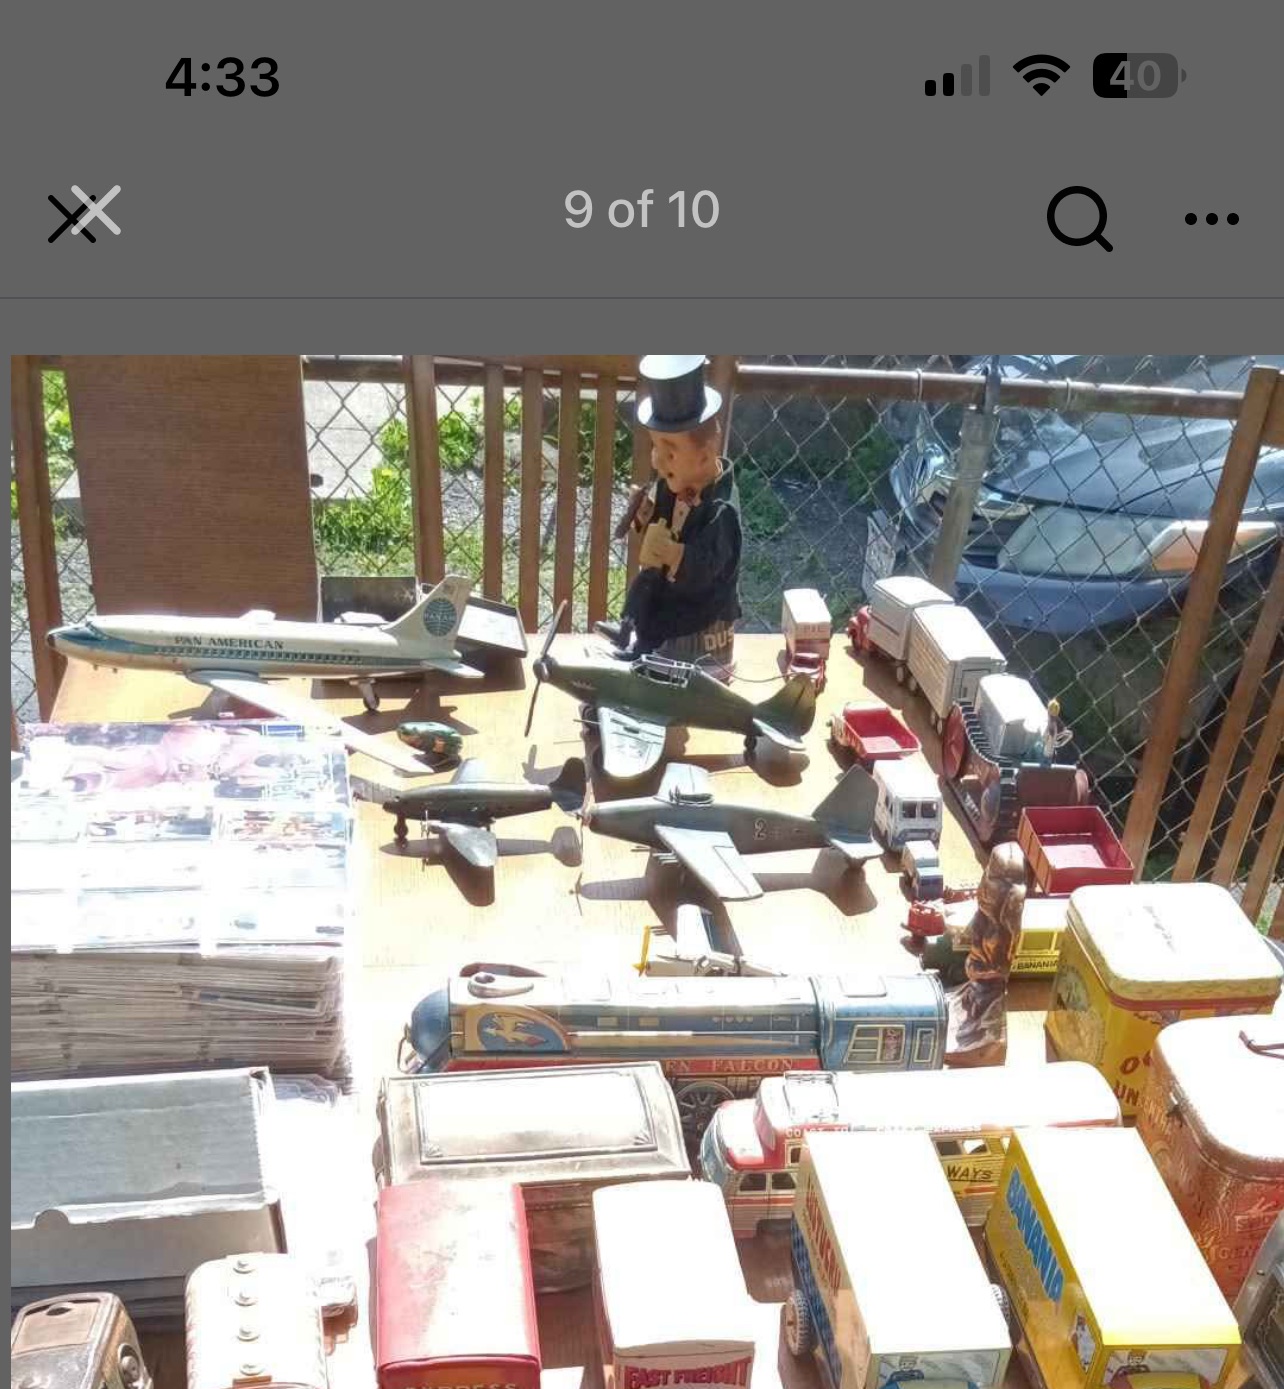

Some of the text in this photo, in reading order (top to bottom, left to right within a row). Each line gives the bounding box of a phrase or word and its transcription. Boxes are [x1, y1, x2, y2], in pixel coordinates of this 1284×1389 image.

[166, 57, 279, 97] 4:33
[1110, 61, 1161, 91] 40
[565, 189, 719, 228] 9 of 10
[174, 635, 284, 650] PAN AMERICAN
[712, 1058, 793, 1073] FALCON
[946, 1164, 993, 1182] WAYS
[1006, 1164, 1065, 1302] BANANIA
